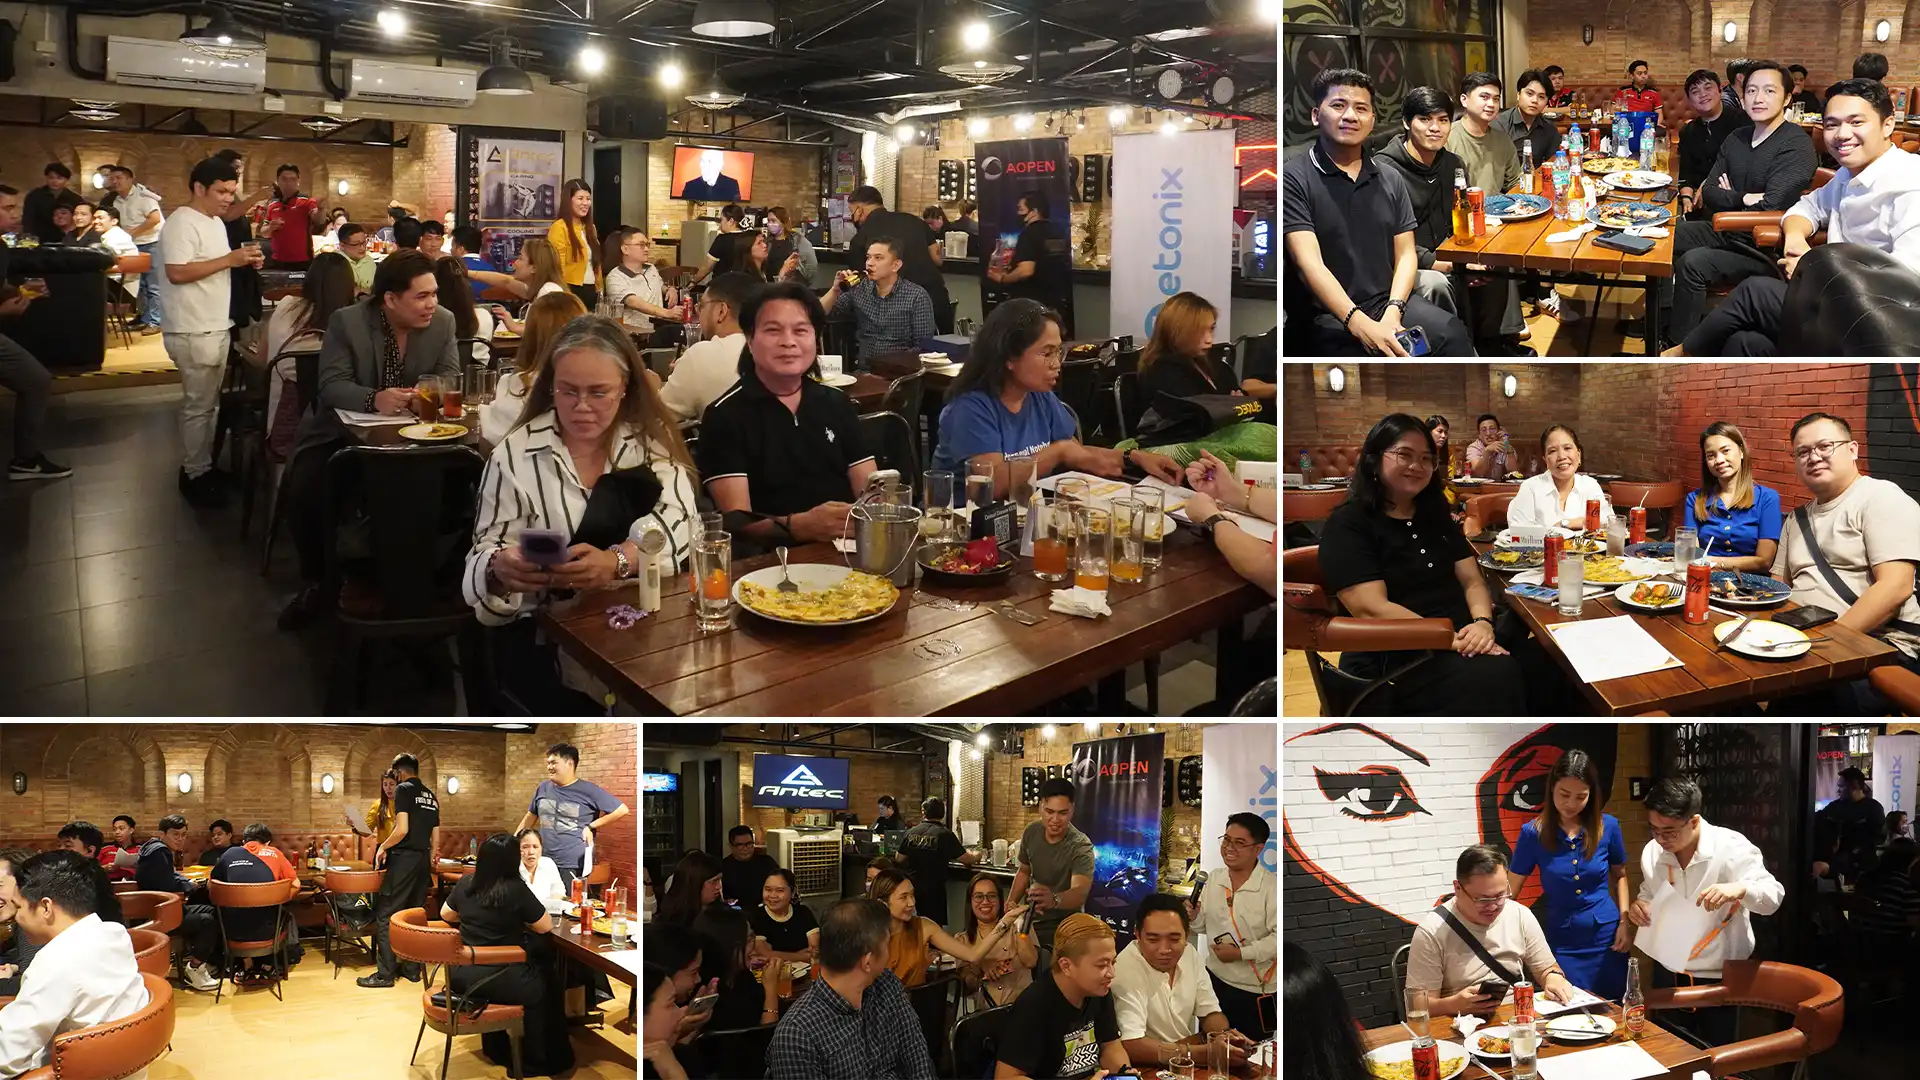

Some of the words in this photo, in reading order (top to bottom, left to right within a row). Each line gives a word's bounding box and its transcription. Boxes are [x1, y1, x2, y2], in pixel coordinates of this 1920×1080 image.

[1006, 160, 1055, 174] AOPEN
[1099, 760, 1149, 776] AOPEN
[758, 785, 844, 799] Antec
